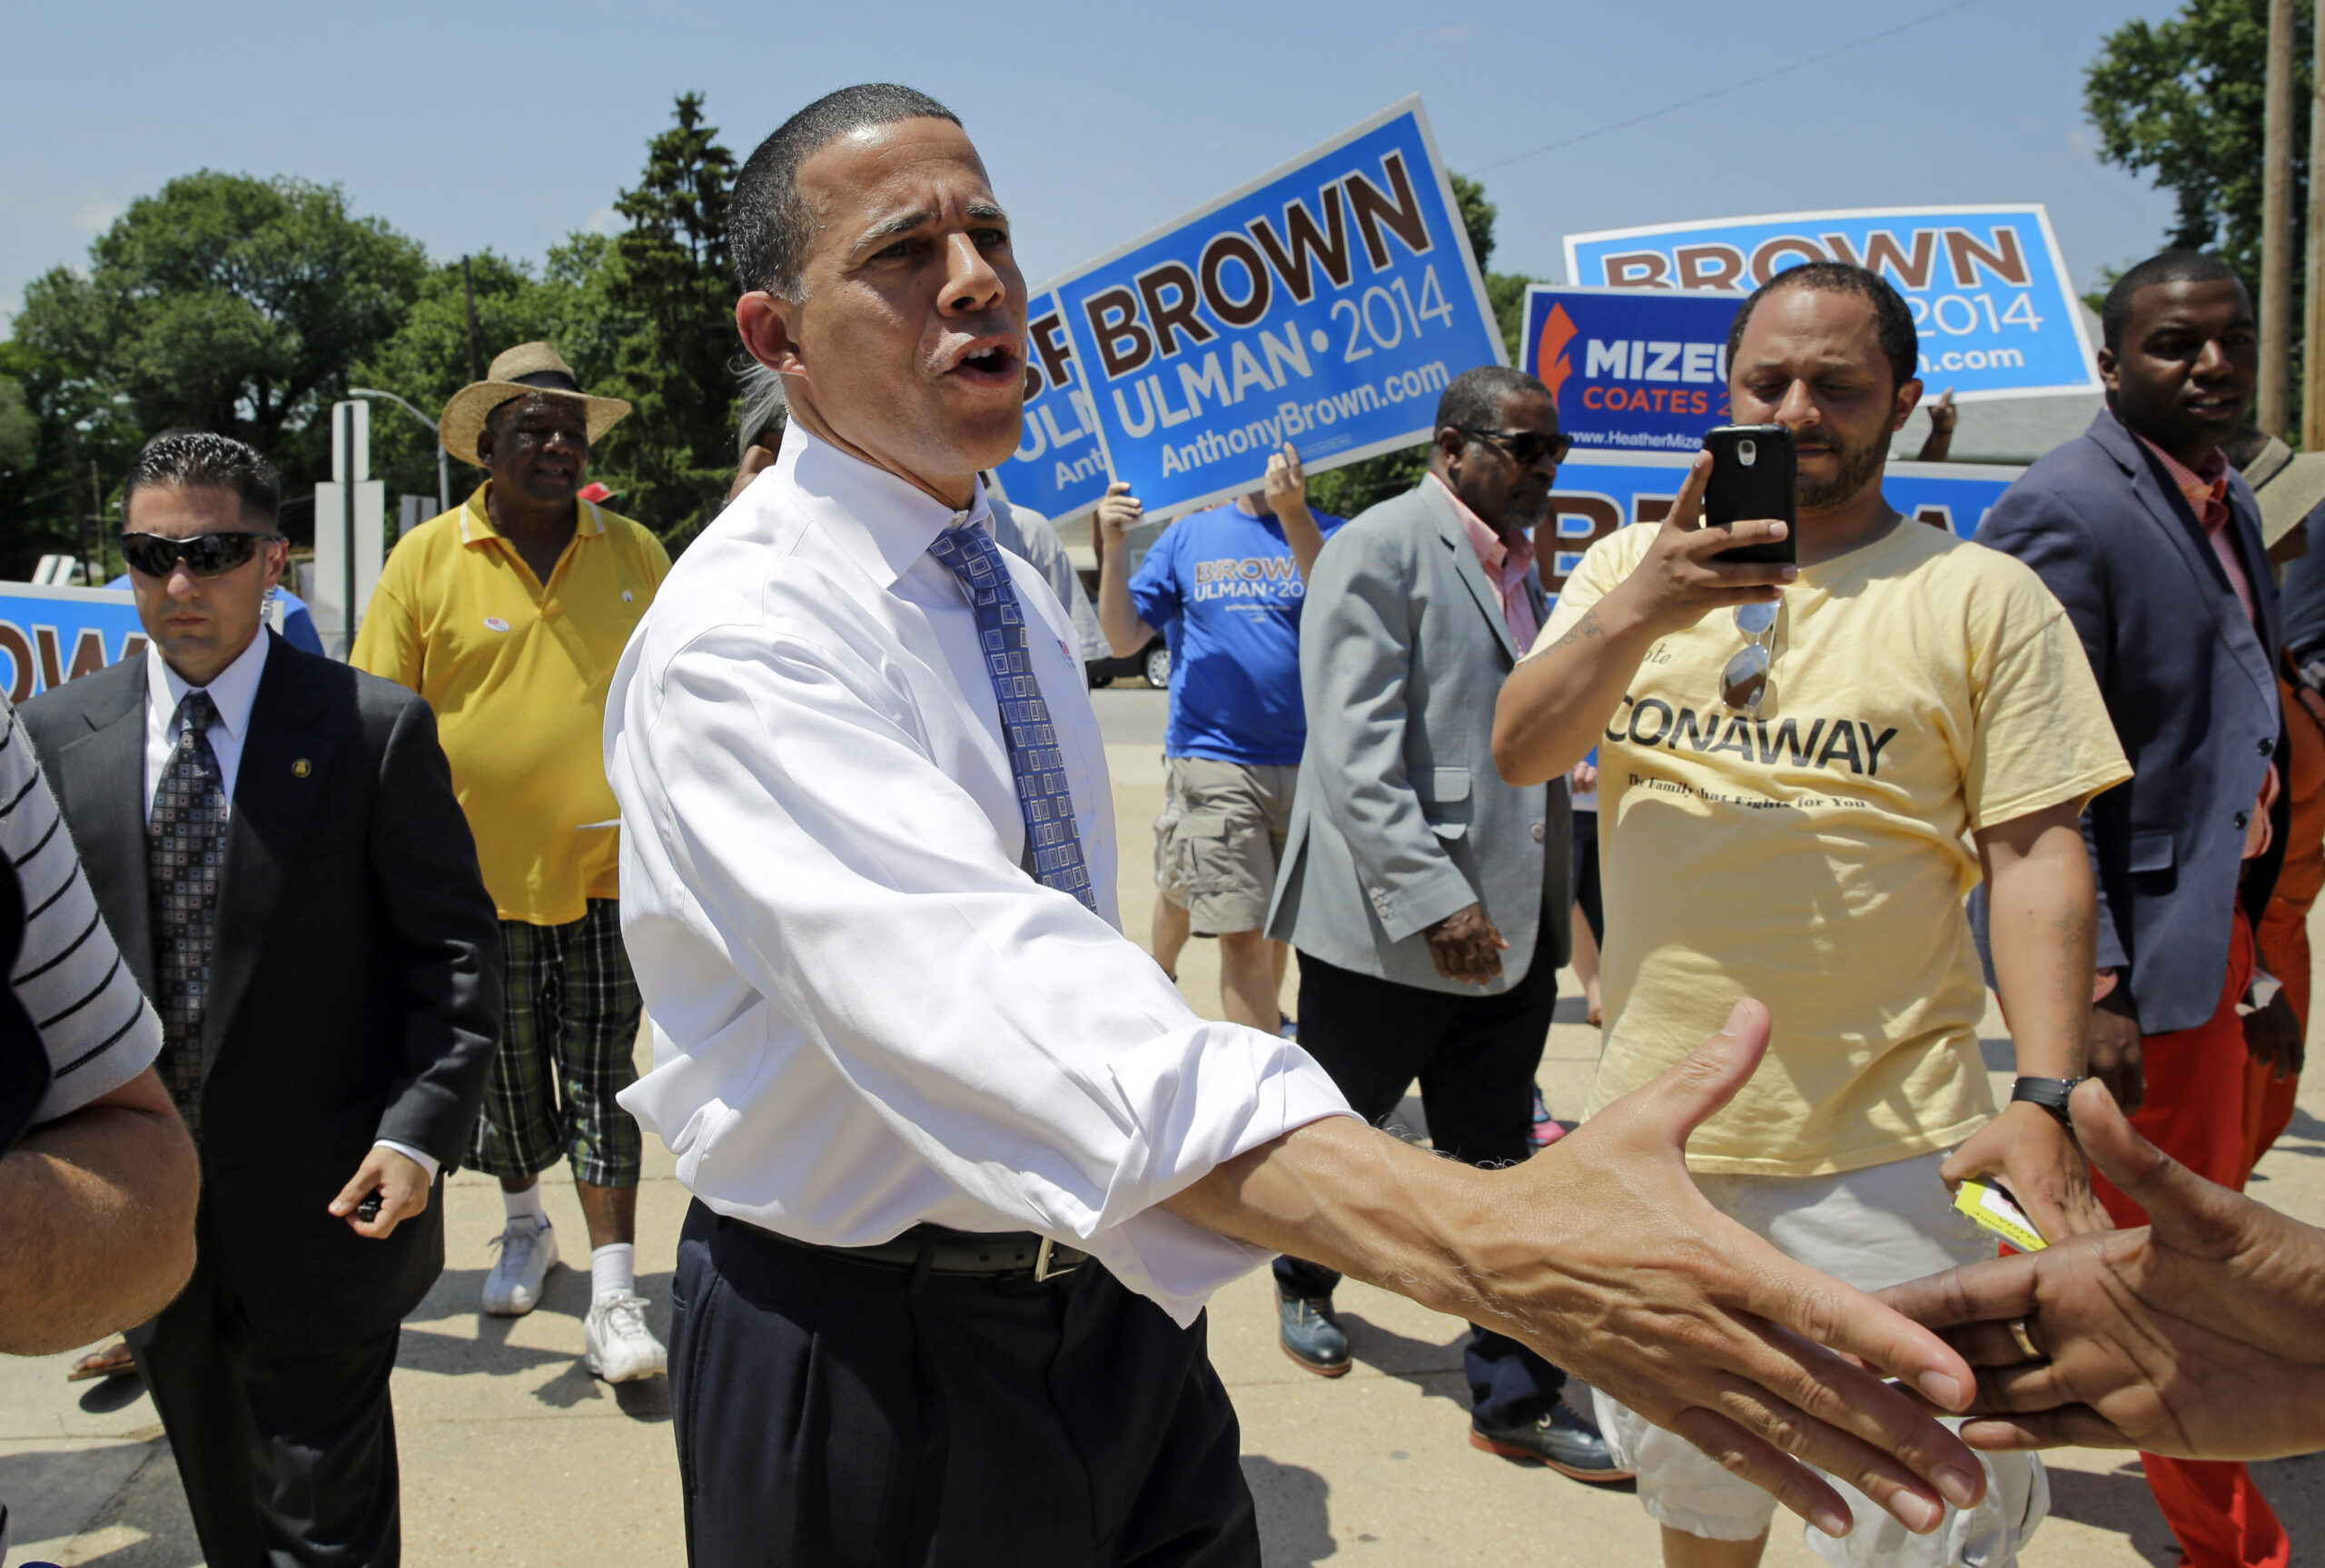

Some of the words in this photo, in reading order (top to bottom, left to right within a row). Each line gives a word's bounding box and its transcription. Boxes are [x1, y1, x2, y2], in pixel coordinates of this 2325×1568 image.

[1082, 148, 1433, 382] BROWN
[1601, 225, 2033, 291] BROWN
[1905, 291, 2043, 337] 2014
[1113, 321, 1312, 438] ULMAN
[1331, 264, 1453, 363] 2014
[1162, 360, 1450, 478] AnthonyBrown.com
[1583, 386, 1708, 415] COATES
[1194, 580, 1267, 602] ULMAN
[1642, 643, 1672, 665] ote
[1648, 776, 1694, 798] Family
[1697, 786, 1727, 802] hat
[1797, 795, 1824, 808] for
[1831, 796, 1865, 808] You
